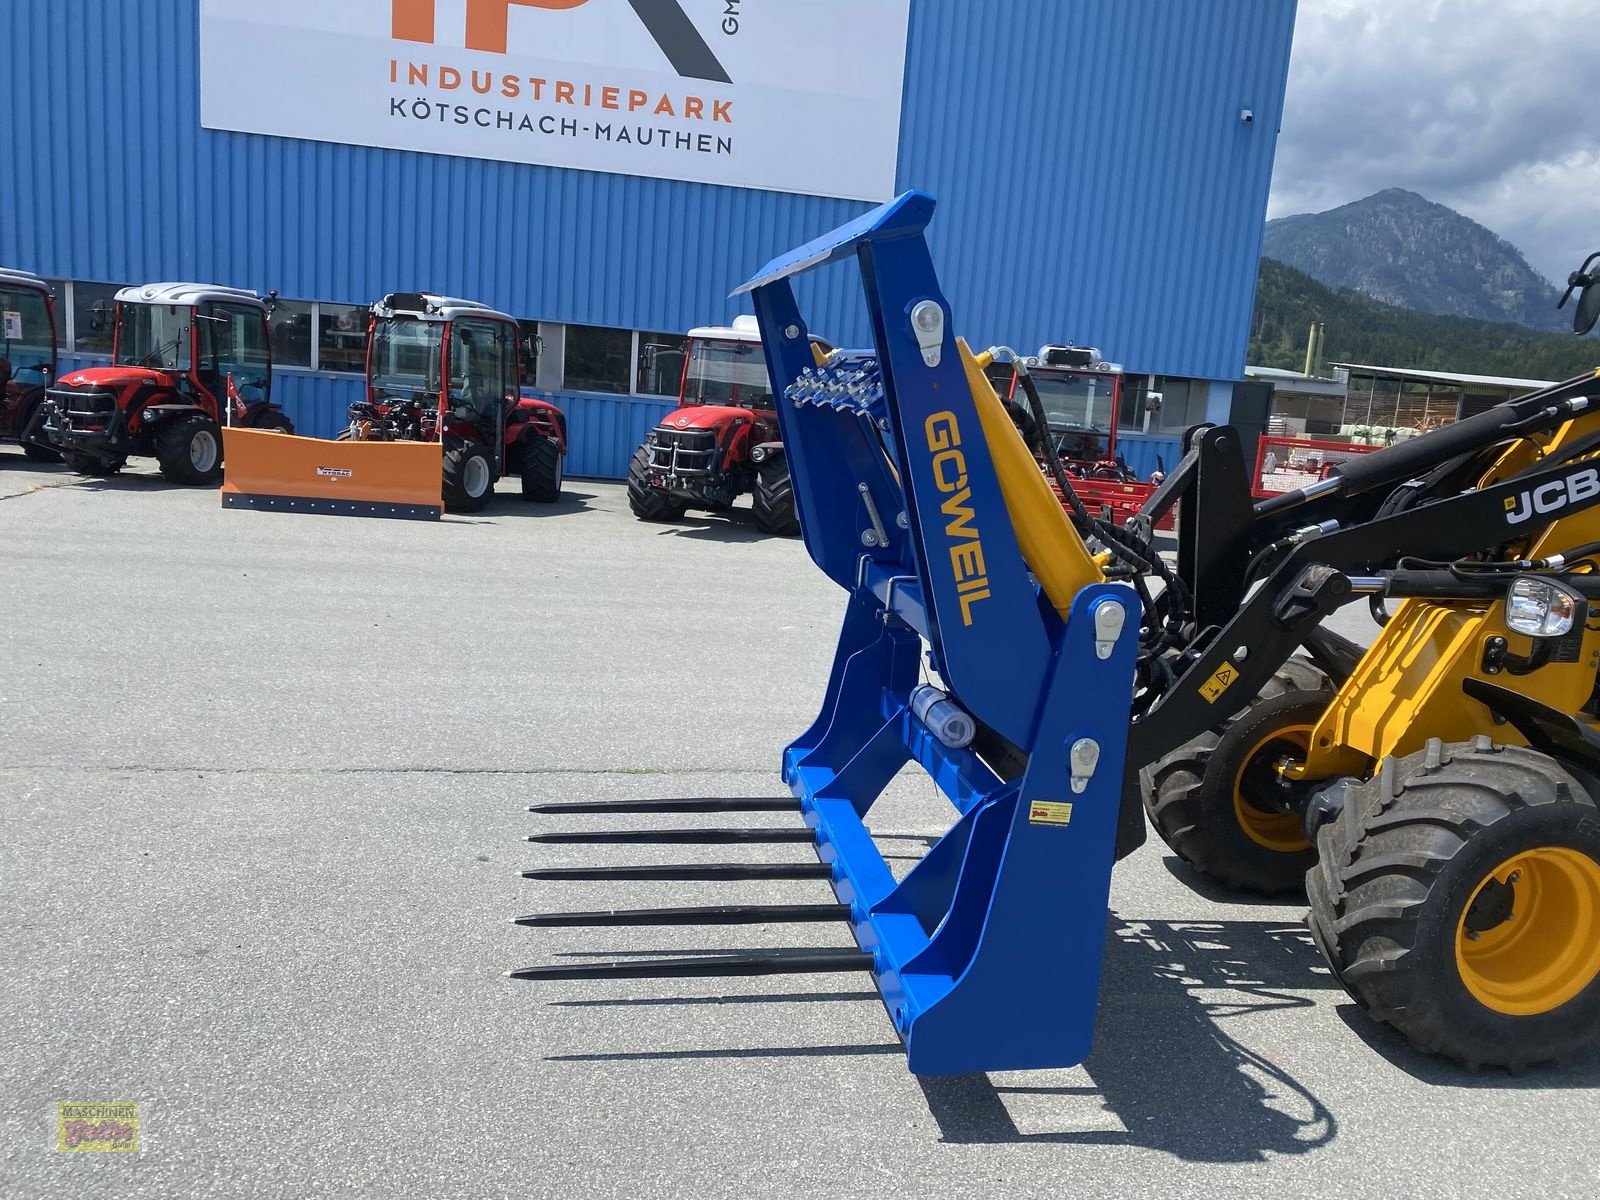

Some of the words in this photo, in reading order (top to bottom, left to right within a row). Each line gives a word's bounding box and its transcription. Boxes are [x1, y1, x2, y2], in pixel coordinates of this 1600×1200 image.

[389, 59, 734, 124] INDUSTRIEPARK
[389, 97, 733, 155] KÖTSCHACH-MAUTHEN
[1506, 468, 1600, 525] JCB
